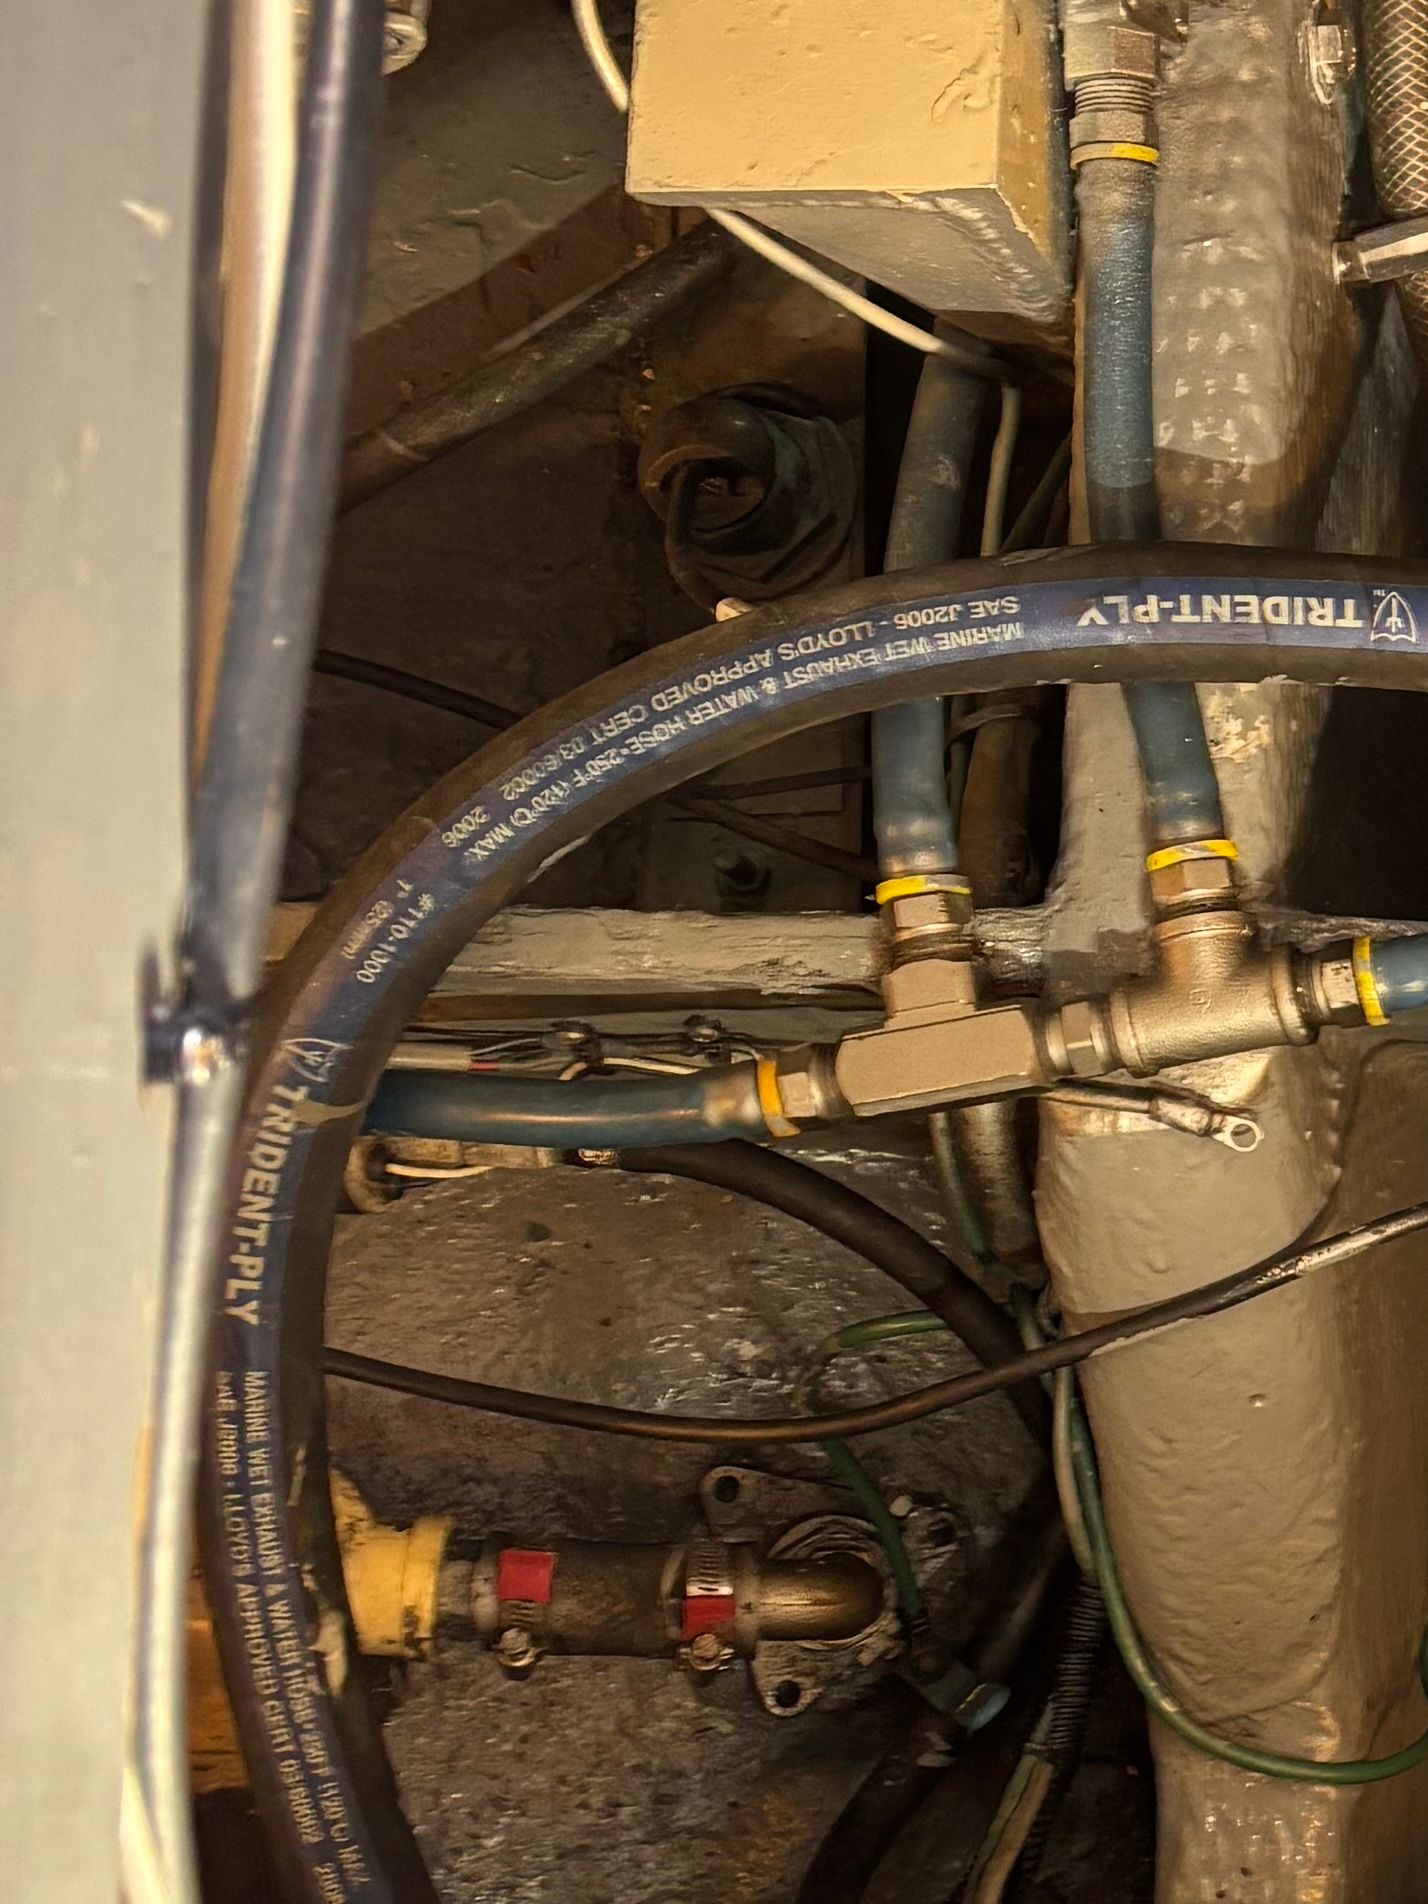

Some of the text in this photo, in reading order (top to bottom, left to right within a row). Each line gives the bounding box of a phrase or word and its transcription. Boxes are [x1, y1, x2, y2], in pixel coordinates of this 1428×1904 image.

[892, 600, 962, 630] J2006
[966, 594, 1018, 618] SAE
[1076, 594, 1366, 629] TRIDENT-PLY
[775, 619, 874, 661] LLOYD'S
[883, 634, 931, 660] WET
[929, 620, 1024, 650] MARINE
[649, 646, 773, 712] APPROVED
[758, 676, 777, 696] &
[782, 646, 876, 690] EXHAUST
[588, 701, 644, 741] CERT
[684, 683, 758, 725] WATER
[439, 803, 487, 849] 2006
[224, 1084, 310, 1326] TRIDENT-PLY
[244, 1369, 270, 1443] MARINE
[247, 1446, 273, 1487] WET
[246, 1491, 287, 1577] EXHAUST
[233, 1579, 279, 1697] APPROVED
[265, 1598, 302, 1667] WATER
